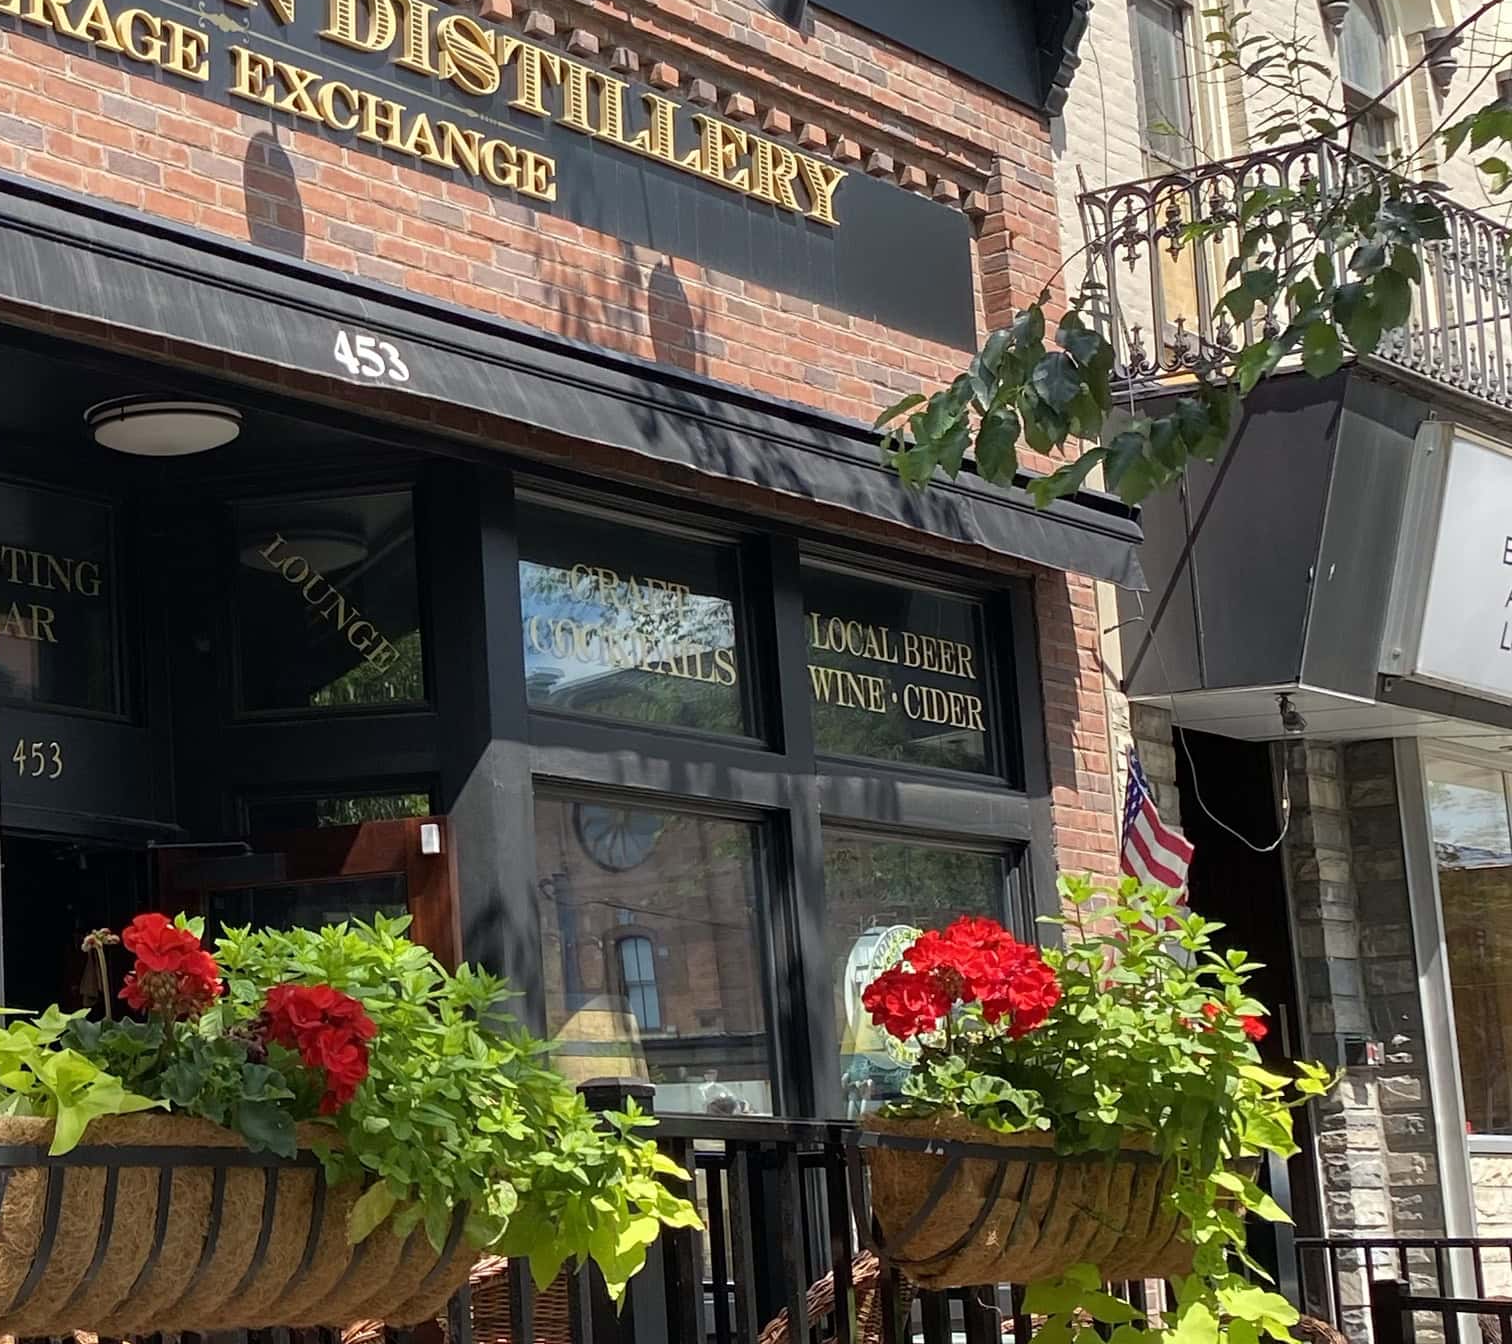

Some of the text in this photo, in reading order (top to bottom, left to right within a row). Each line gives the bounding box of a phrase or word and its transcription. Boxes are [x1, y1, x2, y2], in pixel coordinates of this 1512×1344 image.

[228, 45, 558, 202] EXCHANGE
[333, 330, 410, 382] 453
[258, 532, 401, 673] LOUNGE
[569, 564, 690, 619] CRAFT
[810, 612, 976, 679] LOCAL BEER
[807, 664, 986, 731] WINE CIDER
[13, 739, 63, 779] 453
